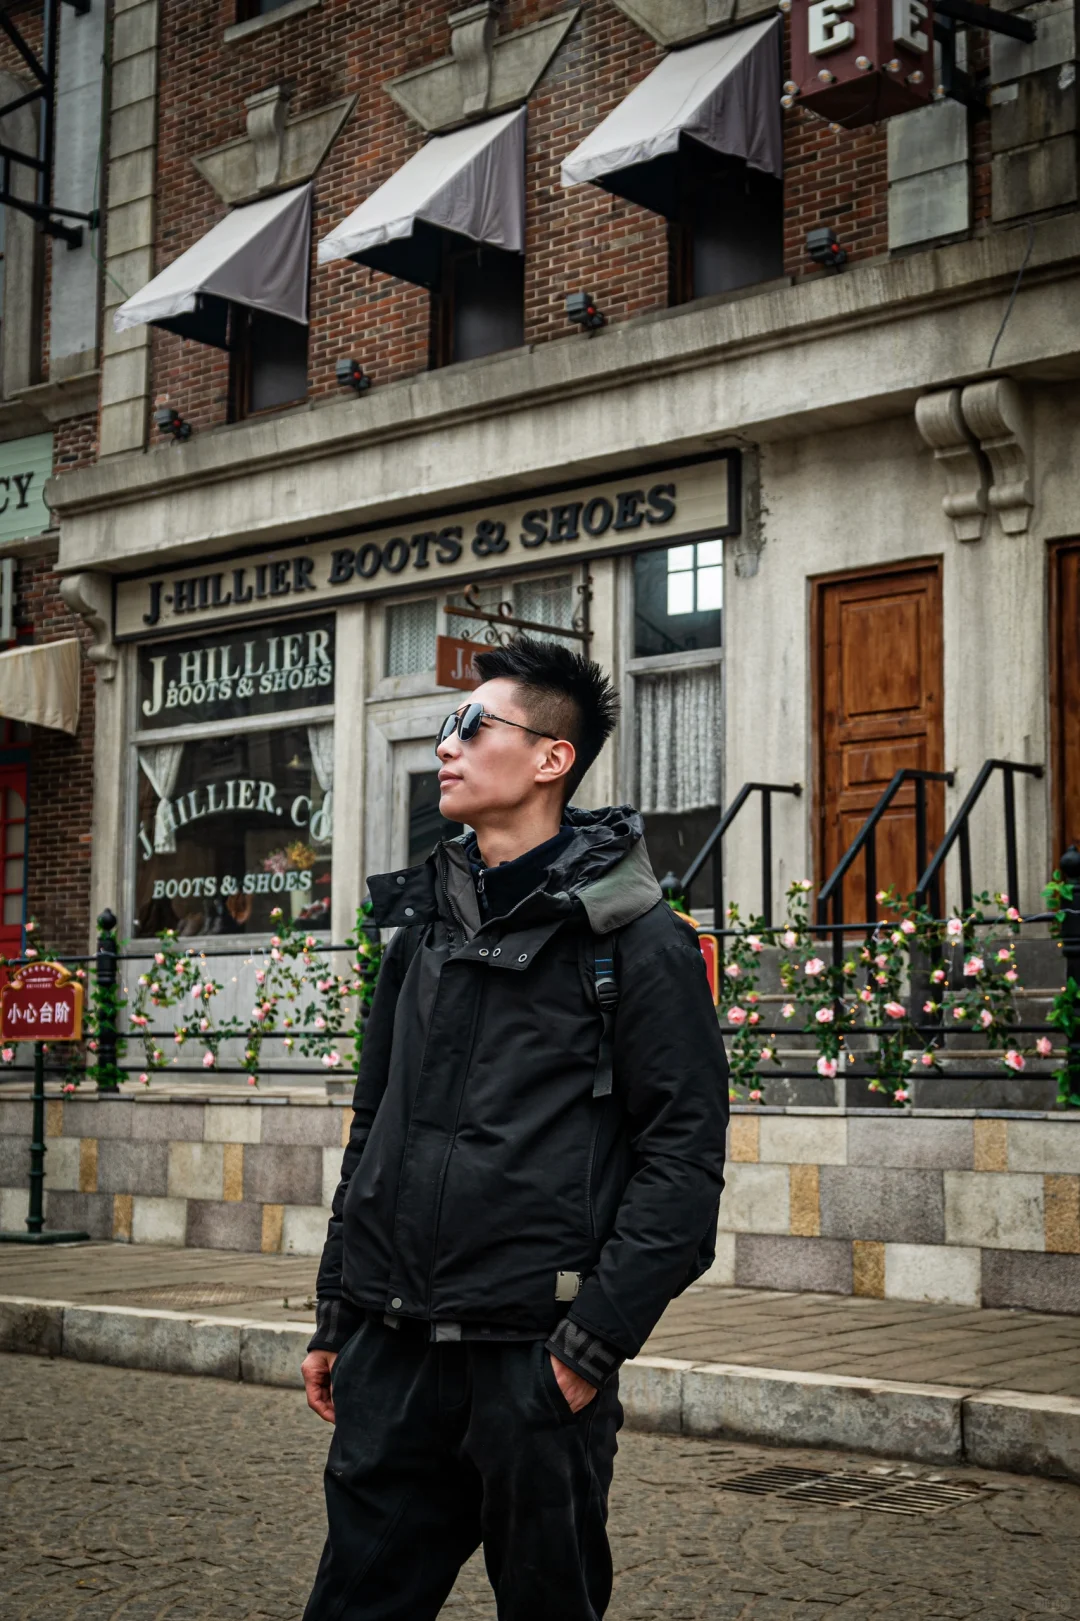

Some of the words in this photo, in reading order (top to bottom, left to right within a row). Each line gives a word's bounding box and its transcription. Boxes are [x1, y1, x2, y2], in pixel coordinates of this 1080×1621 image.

[328, 526, 464, 584] BOOTS
[471, 518, 510, 557] &
[519, 483, 676, 548] SHOES
[165, 679, 232, 708] BOOTS
[236, 676, 254, 699] &
[259, 662, 332, 694] SHOES
[152, 876, 217, 900] BOOTS
[220, 874, 239, 896] &
[242, 869, 312, 895] SHOES
[7, 1001, 71, 1024] 小心台阶
